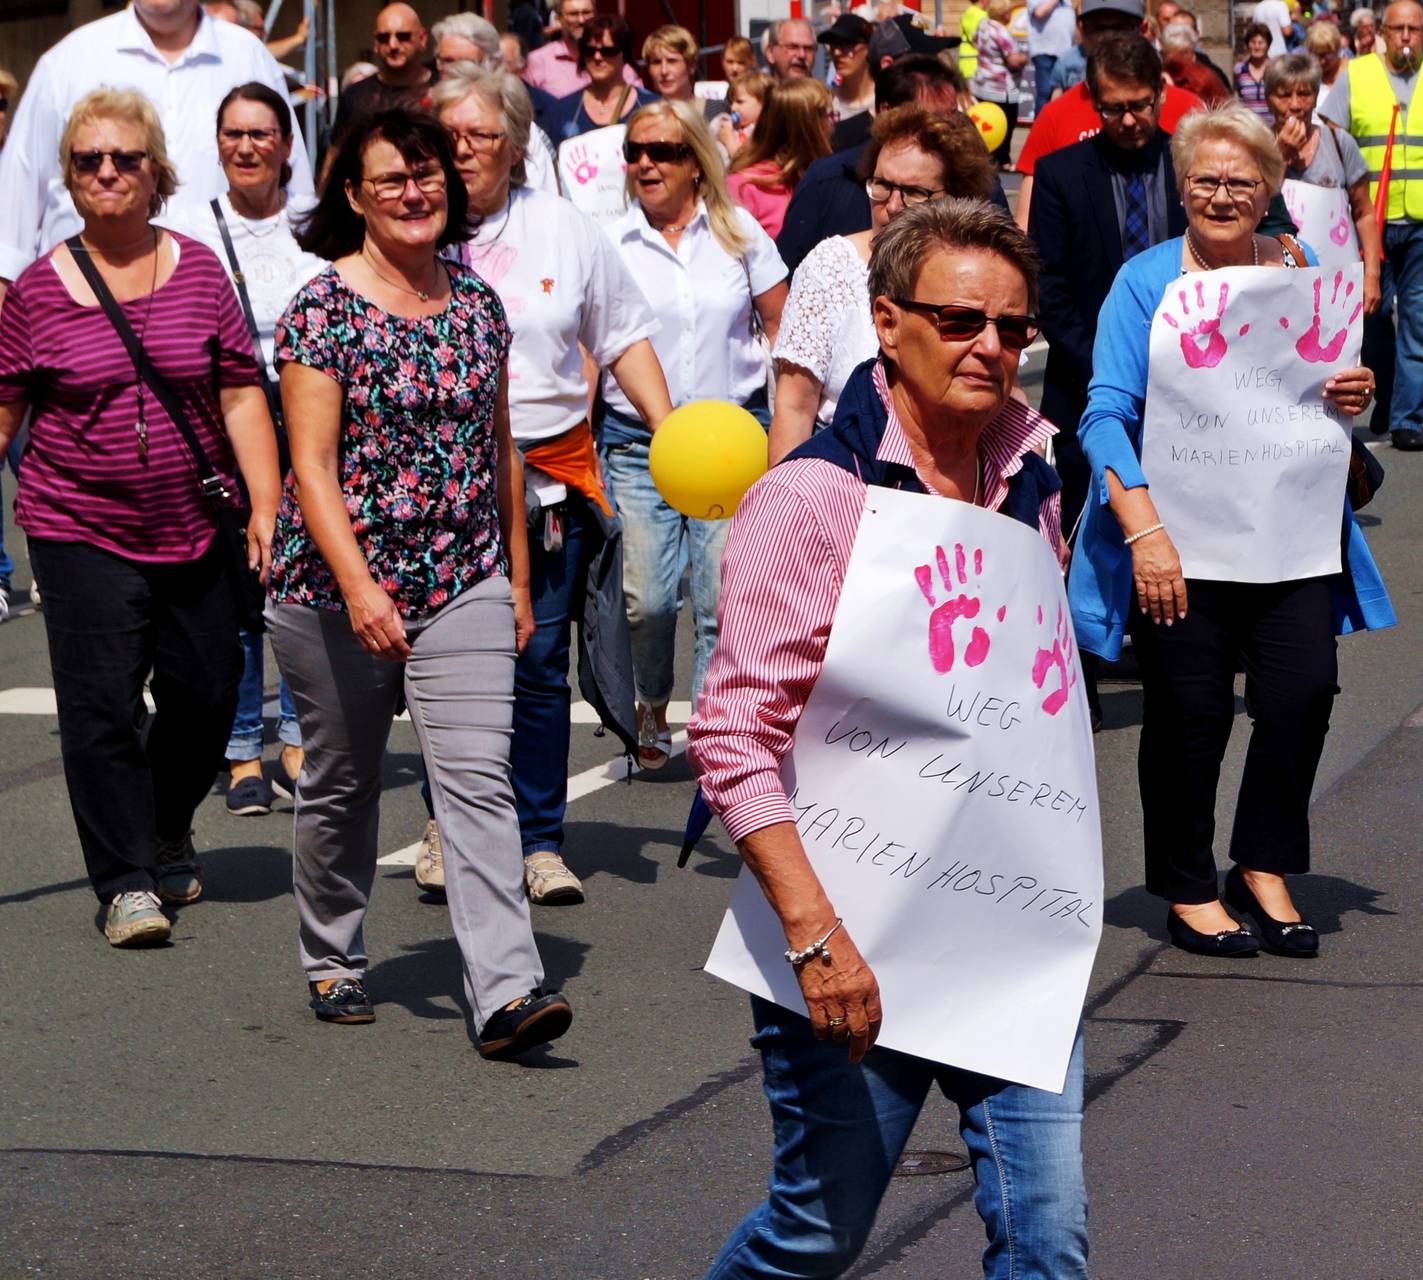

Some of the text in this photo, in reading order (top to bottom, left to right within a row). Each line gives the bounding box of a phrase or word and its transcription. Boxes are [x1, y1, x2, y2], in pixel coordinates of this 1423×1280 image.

[1235, 367, 1282, 392] WEG
[1179, 404, 1340, 429] VON UNSEREM
[1172, 439, 1344, 466] MARIENHOSPITAL
[945, 684, 1022, 730] WEG
[824, 720, 1087, 823] VON UNSEREM
